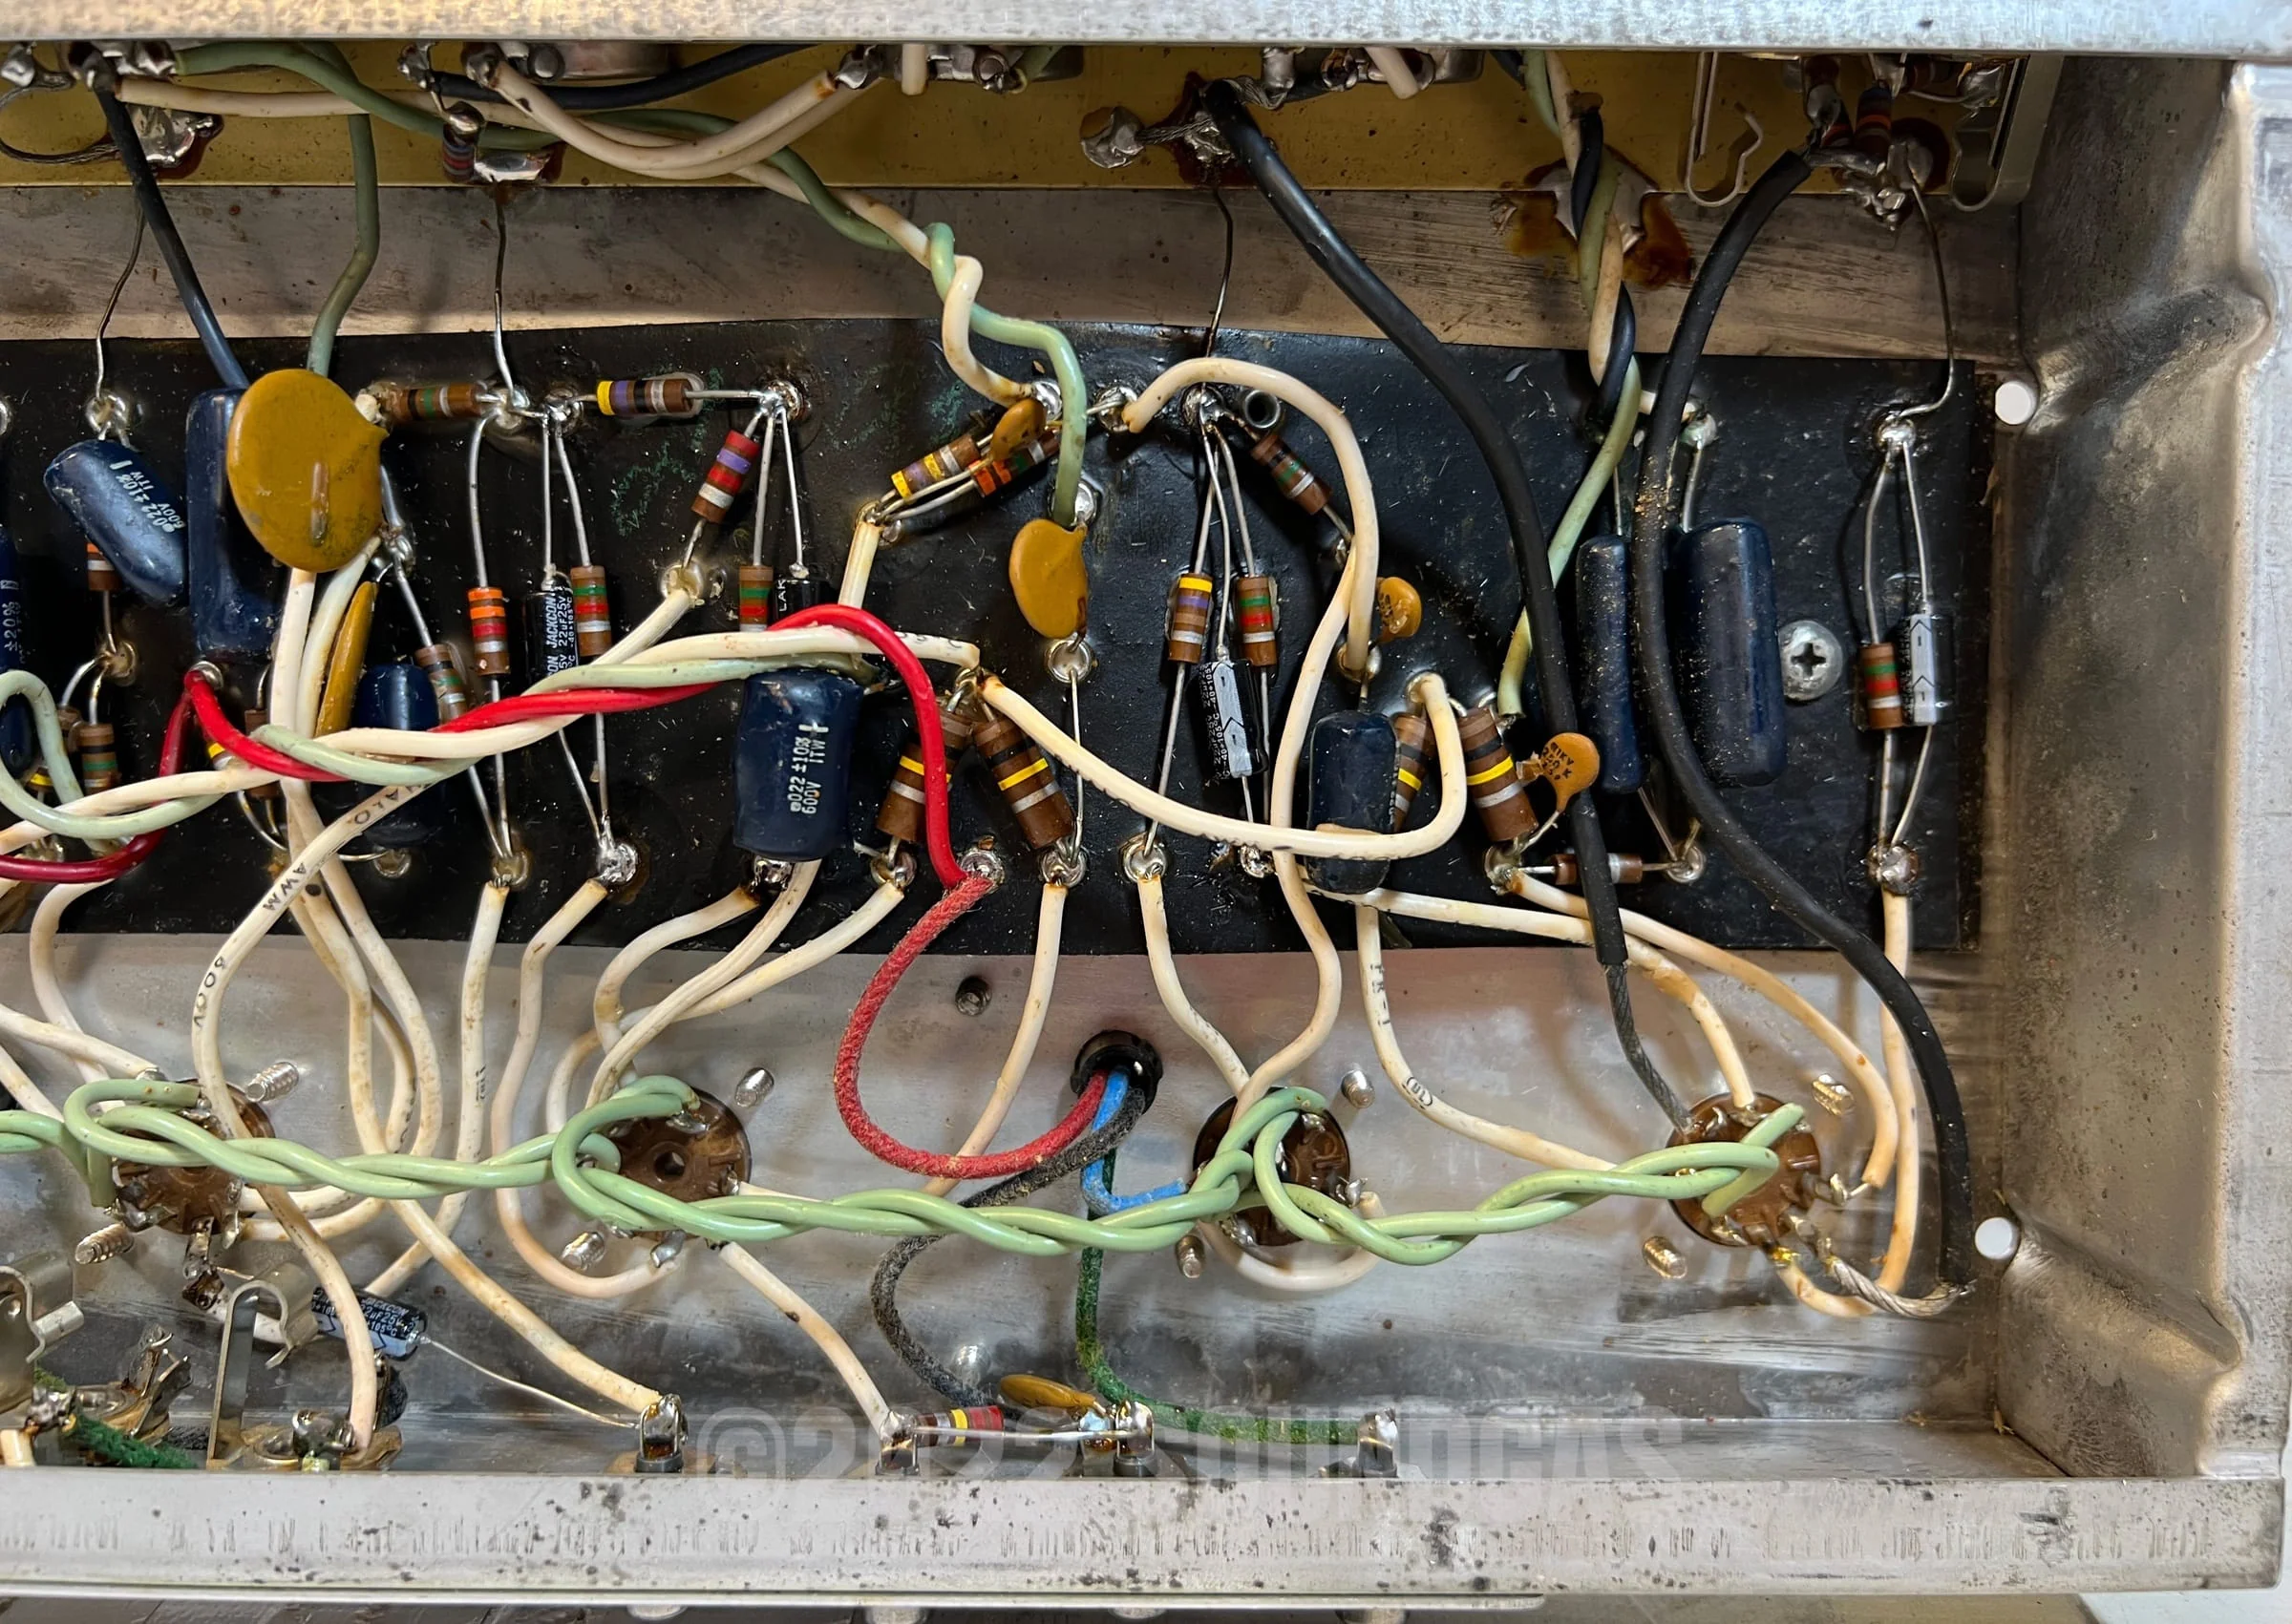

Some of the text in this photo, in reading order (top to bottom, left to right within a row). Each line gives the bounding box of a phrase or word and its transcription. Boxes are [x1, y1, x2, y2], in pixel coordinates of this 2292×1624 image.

[158, 503, 186, 529] 600V
[545, 596, 559, 648] JACKCON
[802, 781, 822, 814] 600V
[263, 862, 307, 912] AWM
